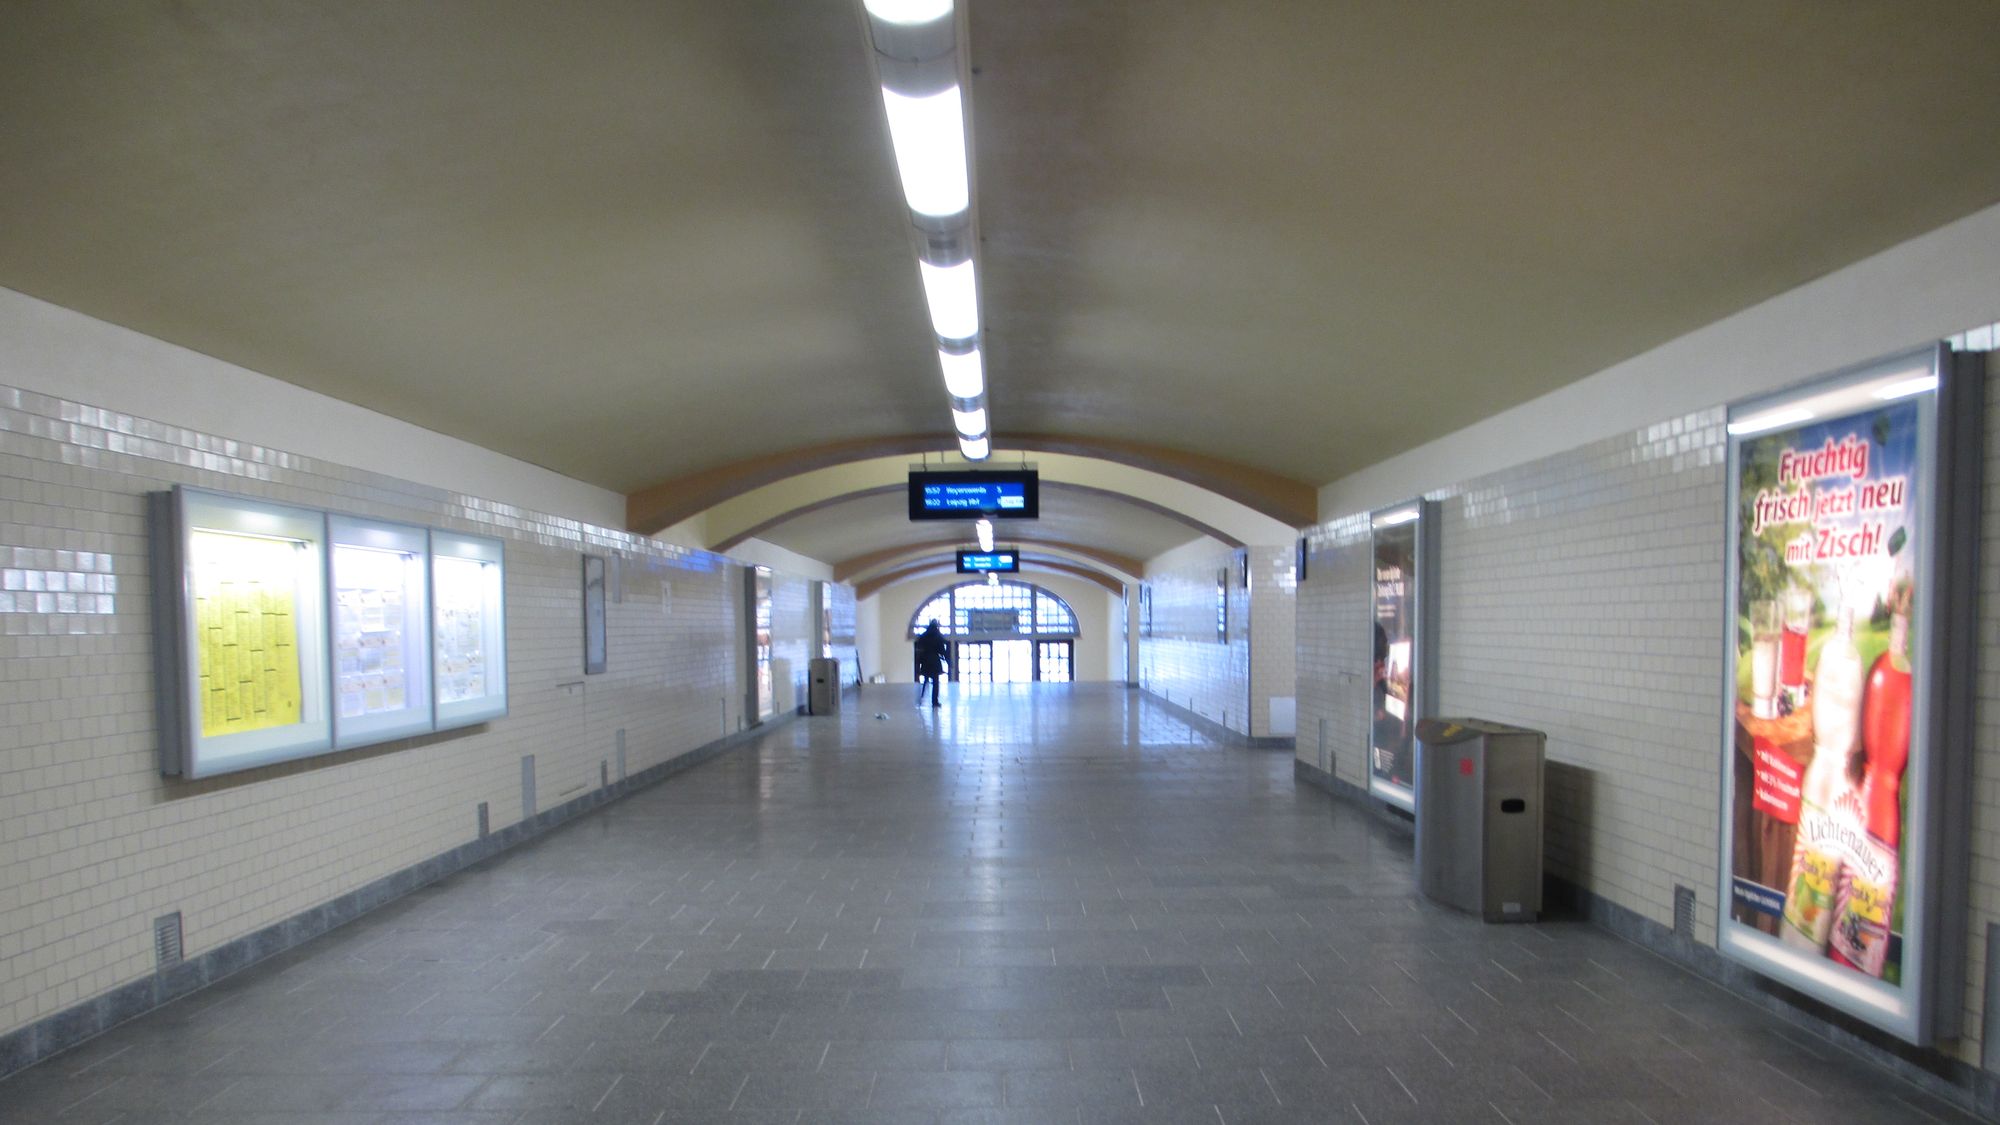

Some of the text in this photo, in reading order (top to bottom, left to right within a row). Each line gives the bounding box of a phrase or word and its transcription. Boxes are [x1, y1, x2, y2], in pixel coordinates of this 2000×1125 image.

[1781, 434, 1867, 481] Fruchtig
[946, 498, 968, 507] Leipzig
[1754, 480, 1903, 532] frisch jetzt neu
[1786, 523, 1883, 561] mit Zisch!
[1809, 818, 1884, 882] Lichtenauer
